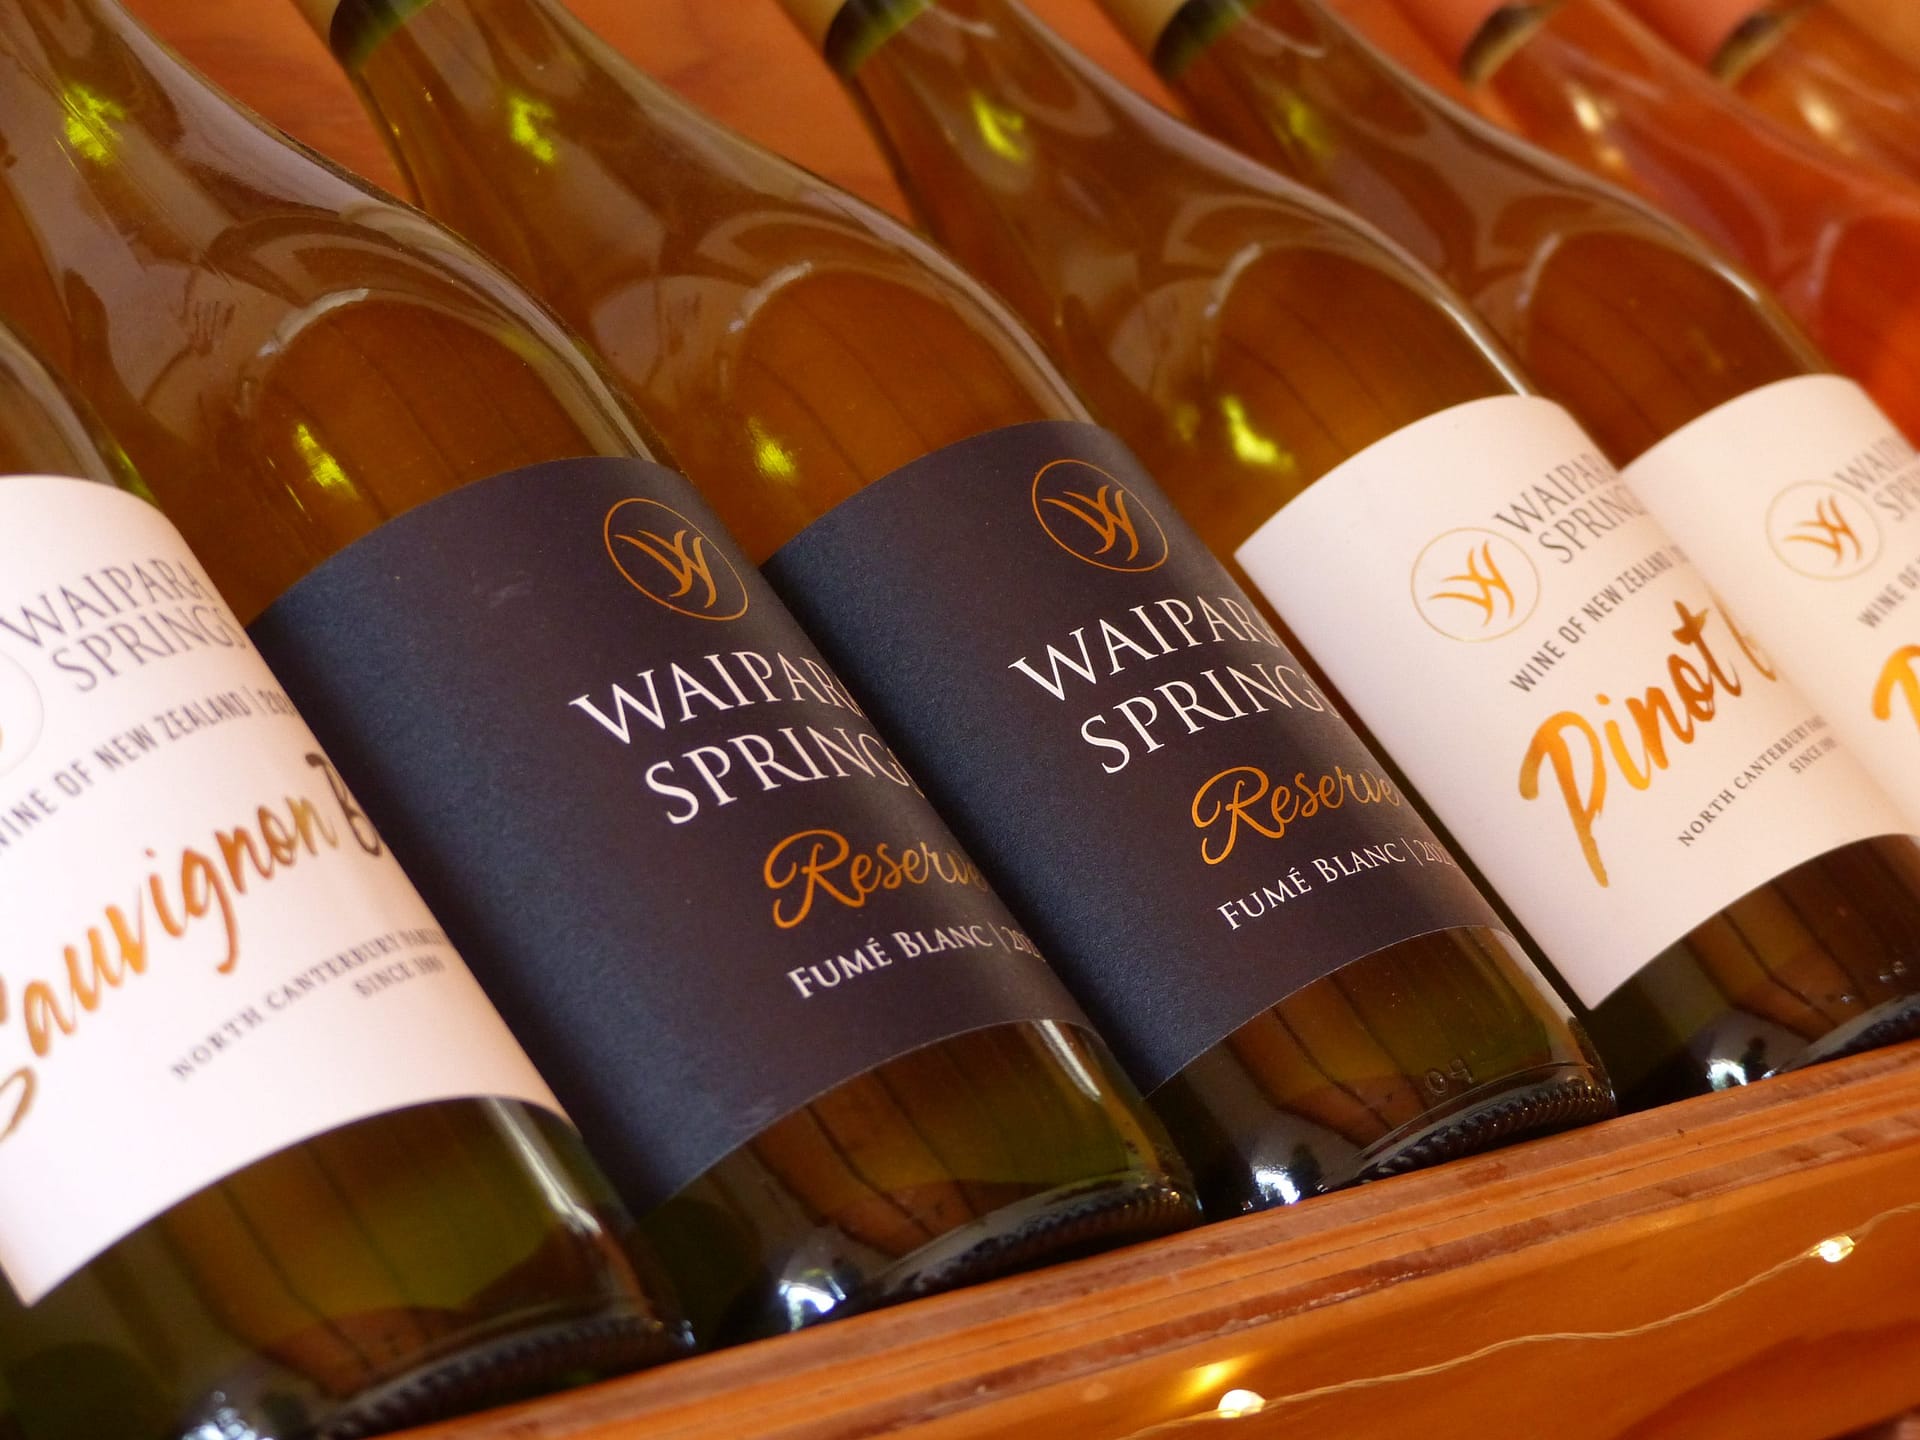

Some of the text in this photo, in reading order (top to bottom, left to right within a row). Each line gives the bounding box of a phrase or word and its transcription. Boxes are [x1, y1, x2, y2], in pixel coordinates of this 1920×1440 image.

[1509, 640, 1566, 693] WINE
[1557, 616, 1588, 644] OF
[1581, 584, 1624, 622] NEW
[1856, 582, 1906, 628] WINE
[54, 760, 94, 797] OF
[93, 724, 160, 771] NEW
[153, 690, 251, 741] ZEALAND
[568, 650, 868, 745] WAIPAR
[1518, 599, 1742, 888] Pinot
[1190, 765, 1400, 882] Reserve
[1677, 724, 1808, 848] NORTH CANTERBURY
[1217, 867, 1312, 931] FUMÉ
[1311, 842, 1406, 883] BLANC
[787, 935, 893, 999] FUMÉ
[892, 925, 993, 960] BLANC
[171, 1006, 263, 1080] NORTH
